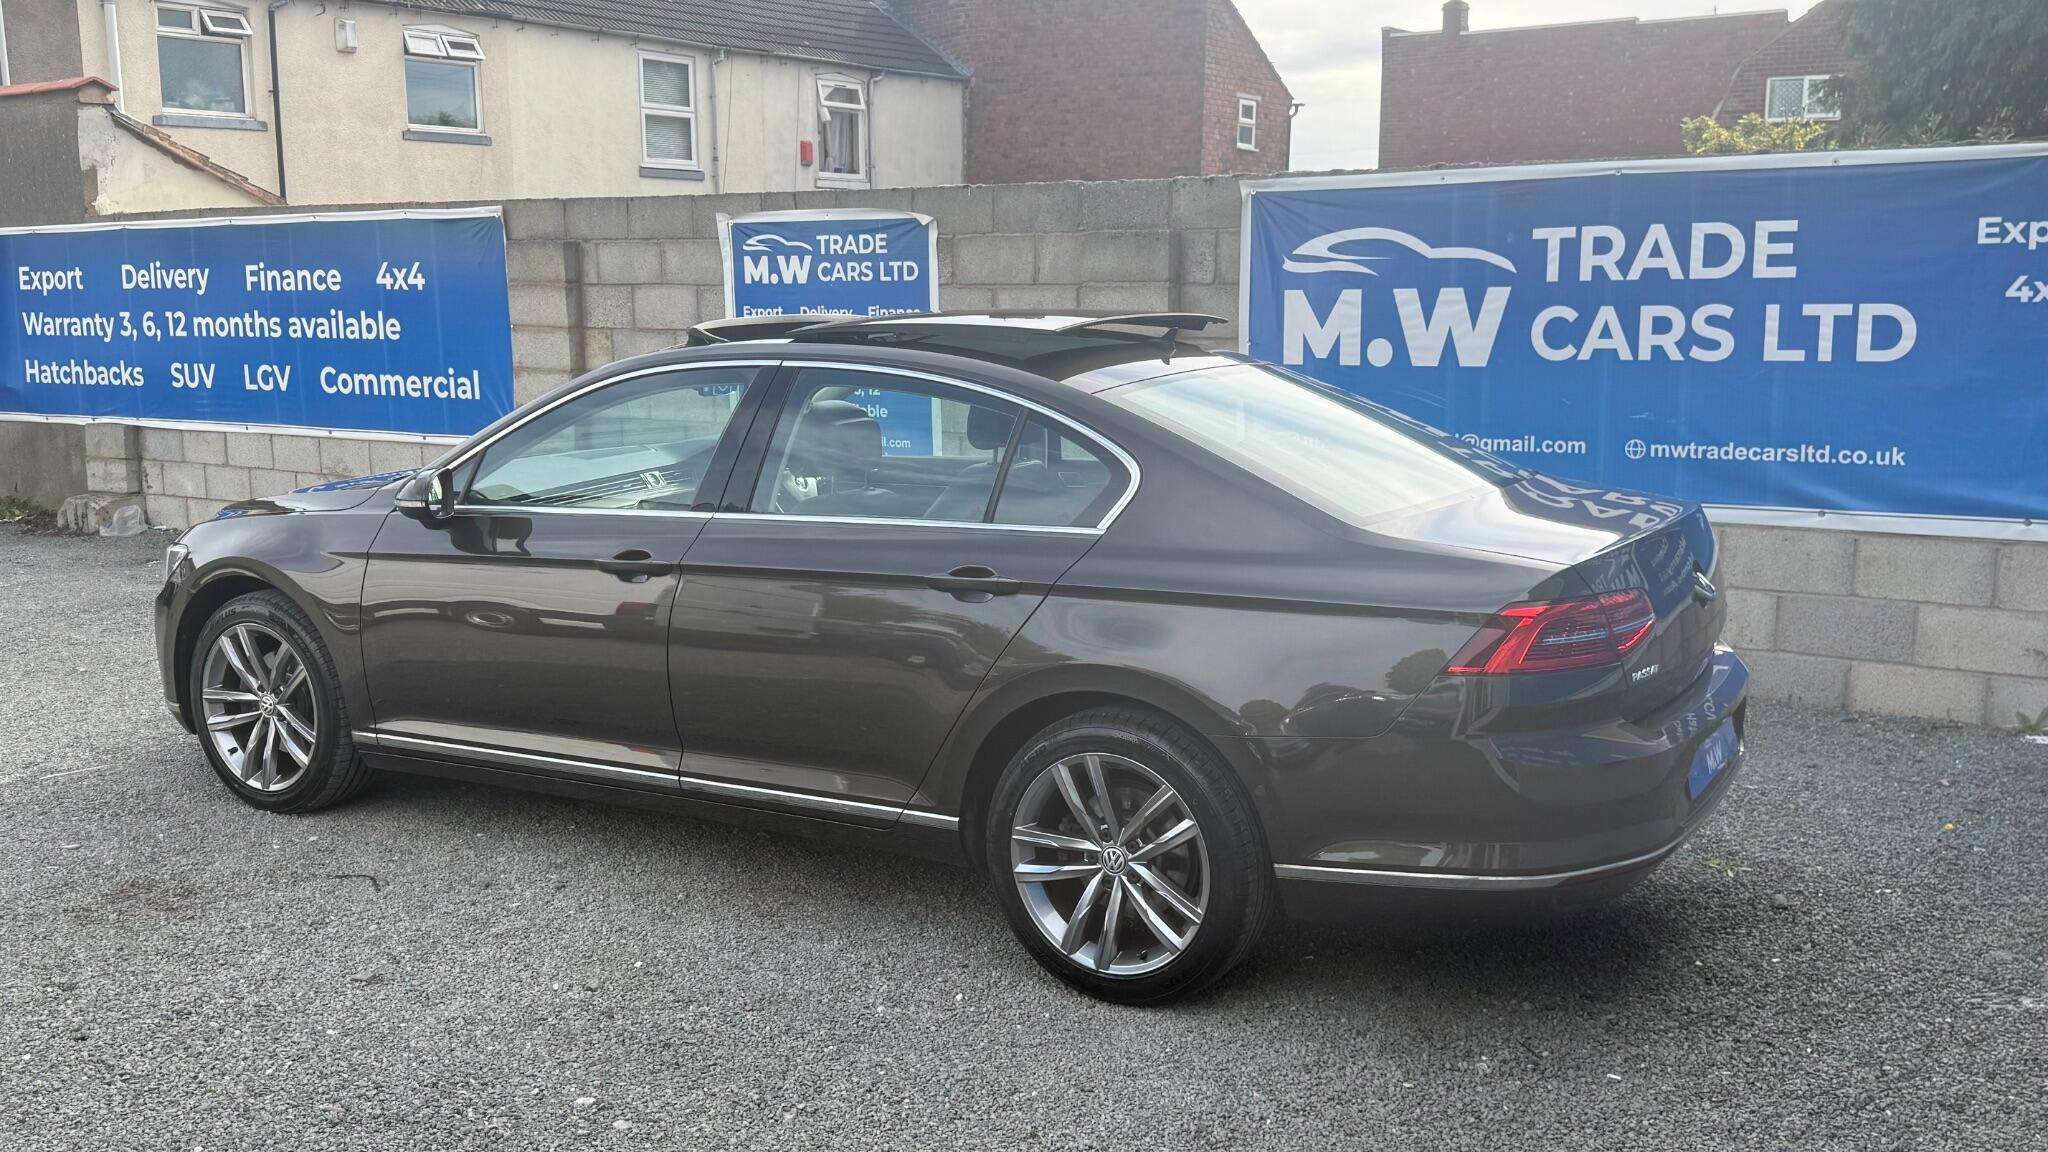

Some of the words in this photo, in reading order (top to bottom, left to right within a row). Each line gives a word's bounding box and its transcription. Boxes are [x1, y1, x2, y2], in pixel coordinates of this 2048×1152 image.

[815, 233, 888, 255] TRADE
[1532, 219, 1799, 283] TRADE
[18, 266, 84, 296] Export
[121, 260, 210, 295] Delivery
[245, 261, 342, 292] Finance
[375, 261, 426, 291] 4x4
[743, 254, 813, 285] M.W
[817, 261, 874, 282] CARS
[879, 261, 919, 282] LTD
[22, 311, 115, 343] Warranty
[119, 311, 138, 342] 3,
[142, 311, 162, 342] 6,
[166, 310, 188, 337] 12
[192, 309, 282, 338] months
[288, 308, 402, 341] available
[1282, 286, 1512, 368] M.W
[1530, 303, 1736, 362] CARS
[1763, 303, 1917, 362] LTD
[25, 359, 145, 387] Hatchbacks
[170, 362, 216, 389] SUV
[243, 364, 291, 392] LGV
[319, 366, 481, 400] Commercial
[1650, 442, 1906, 467] mwtradecarsltd.co.uk
